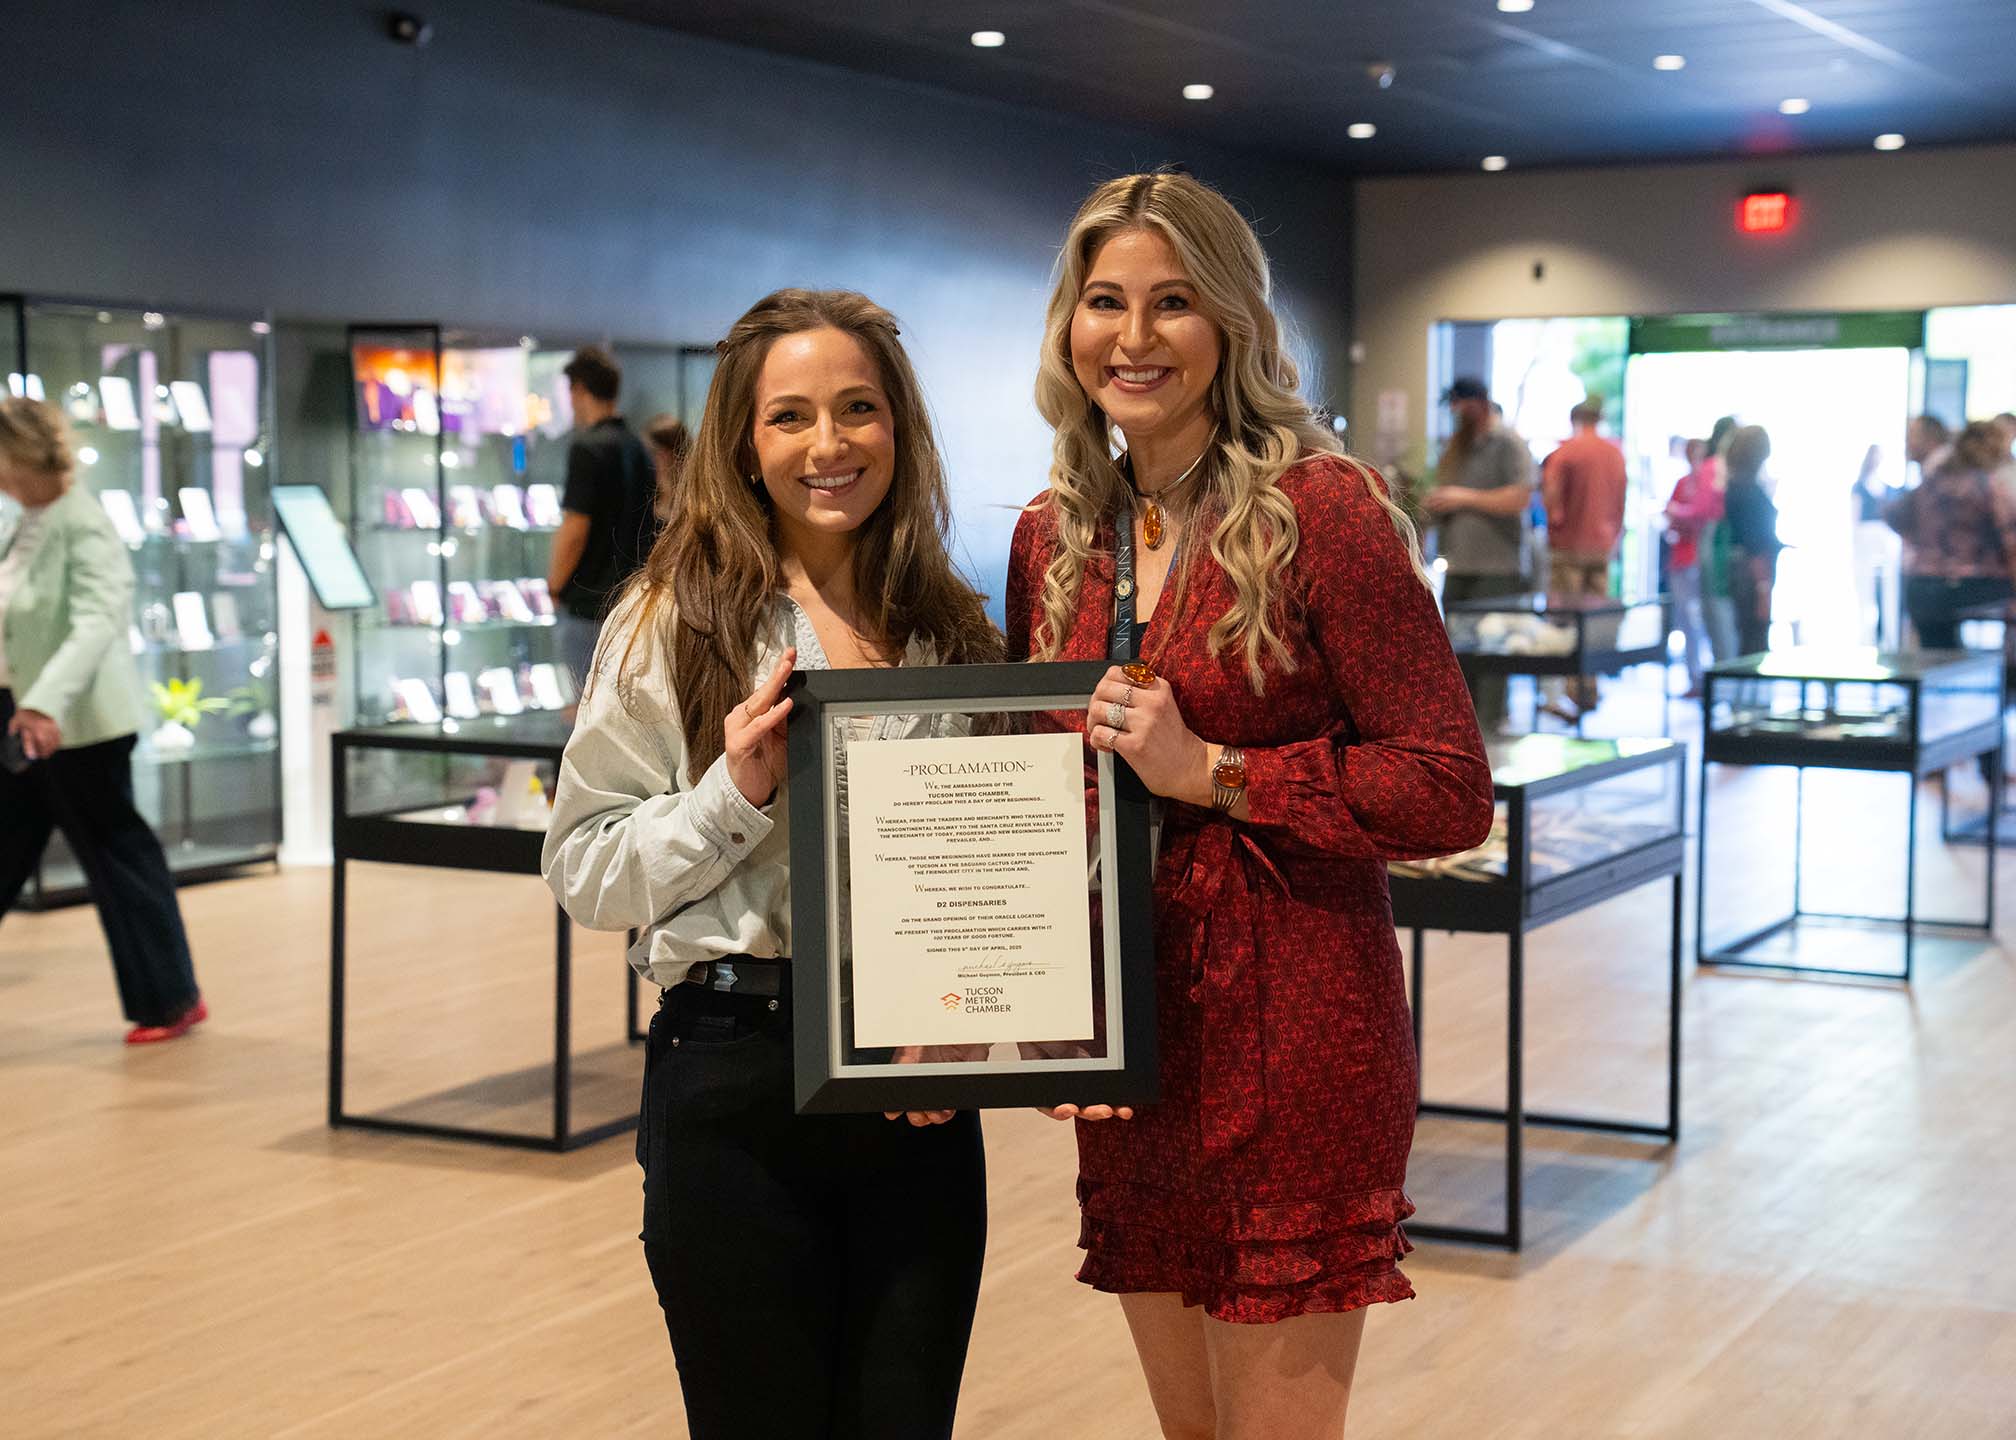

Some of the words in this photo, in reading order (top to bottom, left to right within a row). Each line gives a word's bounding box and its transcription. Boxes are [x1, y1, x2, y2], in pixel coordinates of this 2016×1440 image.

[966, 987, 1003, 996] TUCSON
[965, 996, 998, 1005] METRO
[965, 1004, 1011, 1013] CHAMBER
